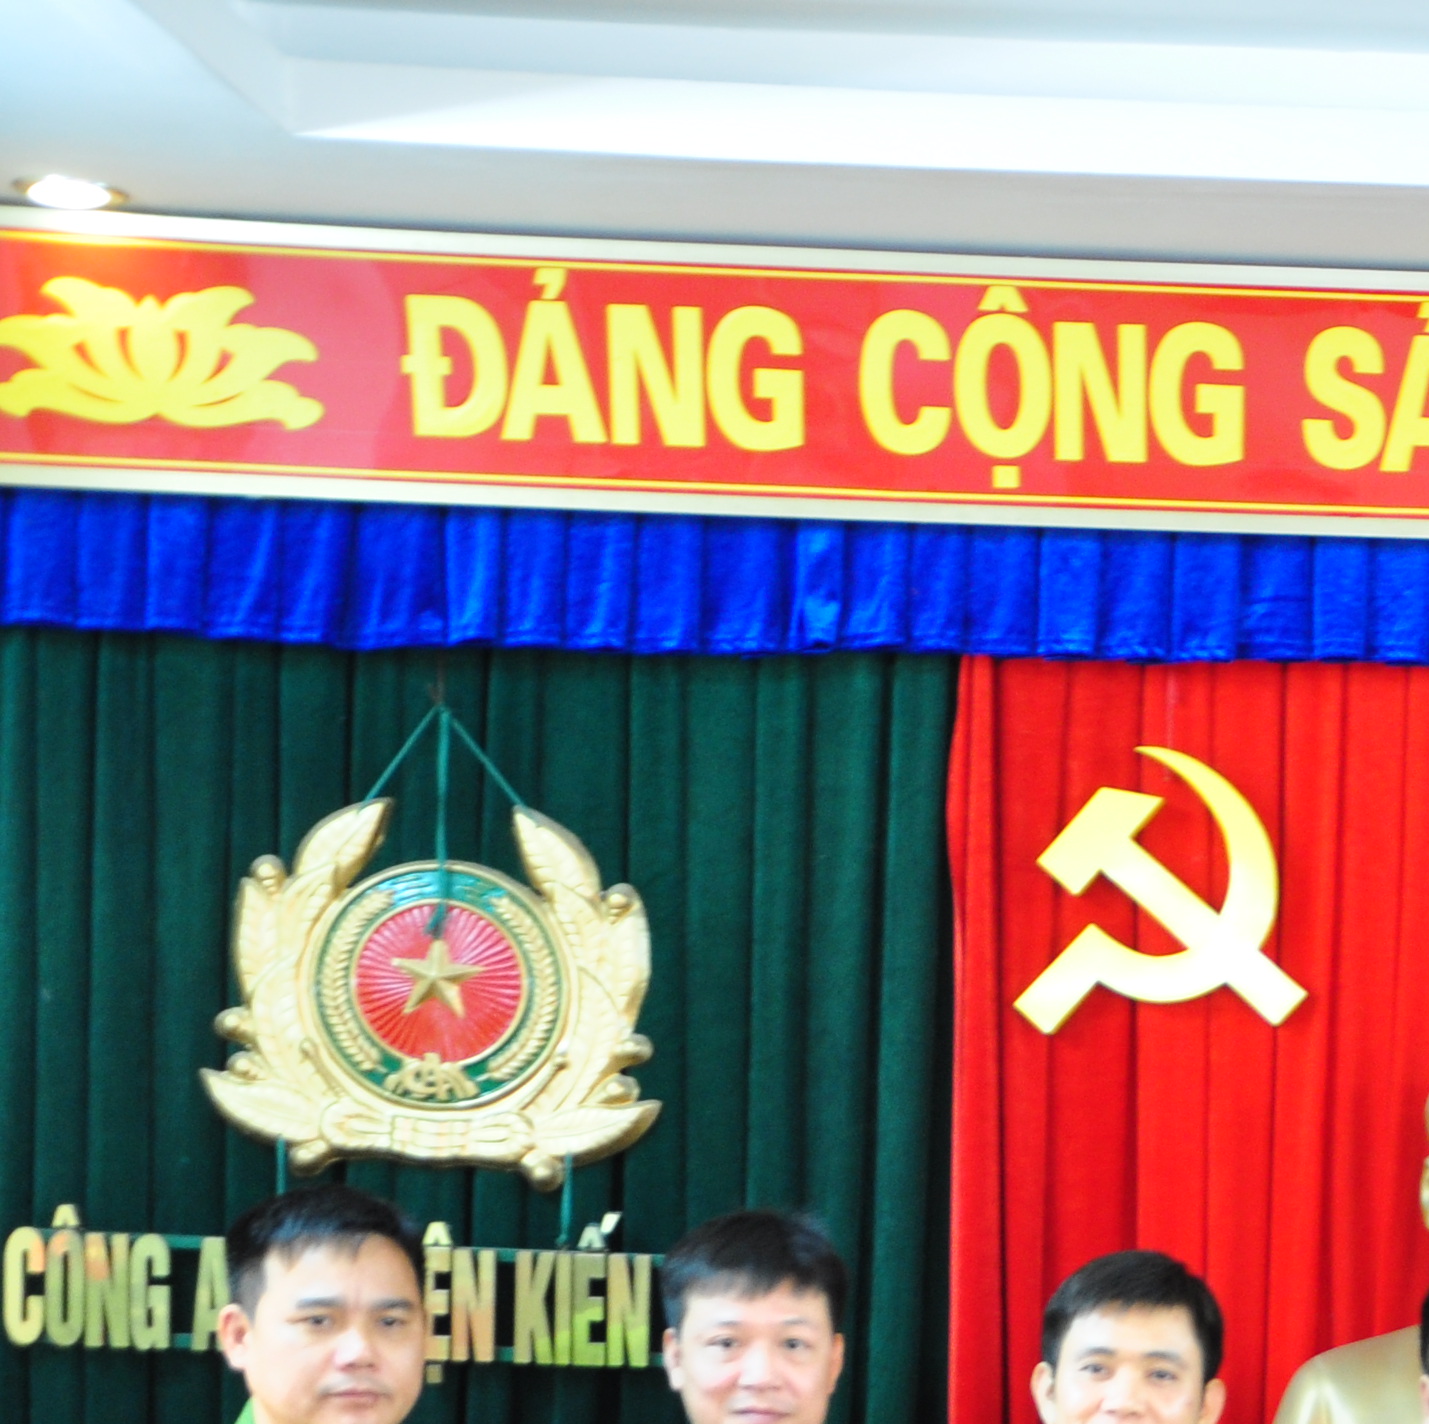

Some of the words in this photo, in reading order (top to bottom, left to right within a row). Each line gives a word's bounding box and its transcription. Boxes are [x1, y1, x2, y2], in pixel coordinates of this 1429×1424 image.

[402, 266, 805, 451] ĐẢNG
[858, 285, 1246, 489] CỘNG
[3, 1203, 171, 1351] CÔNG
[513, 1211, 652, 1368] KIẾN
